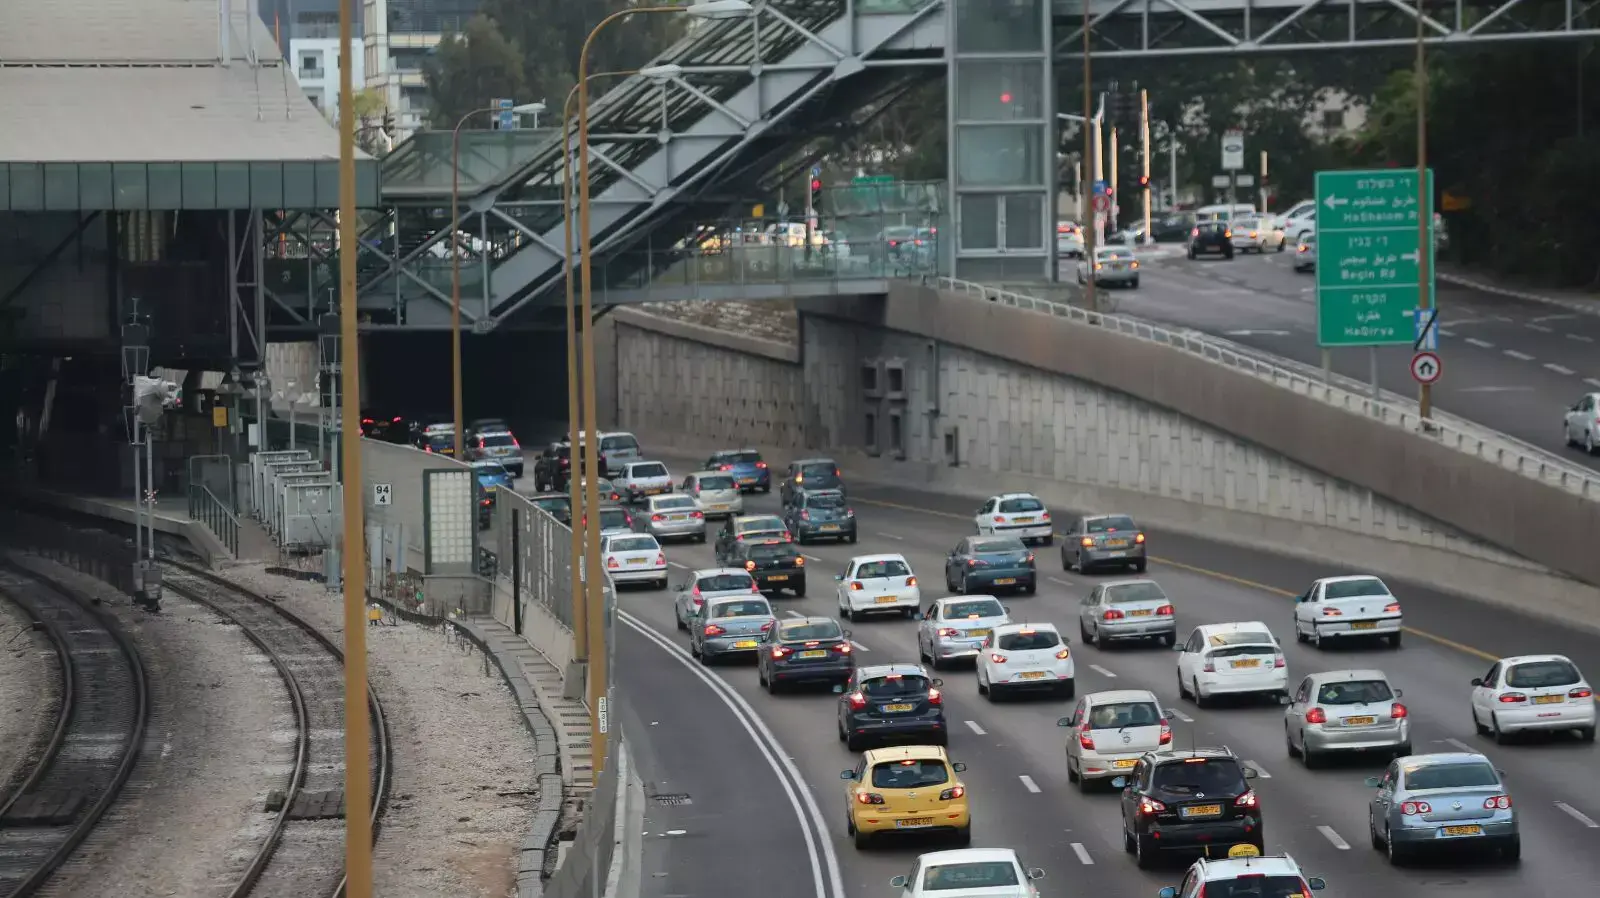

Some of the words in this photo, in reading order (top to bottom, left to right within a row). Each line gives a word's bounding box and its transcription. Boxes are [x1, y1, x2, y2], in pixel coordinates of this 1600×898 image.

[1343, 211, 1404, 222] HaShalom
[1341, 269, 1375, 282] Begin
[1380, 268, 1396, 278] Rd
[376, 485, 389, 494] 94
[380, 495, 386, 503] 4
